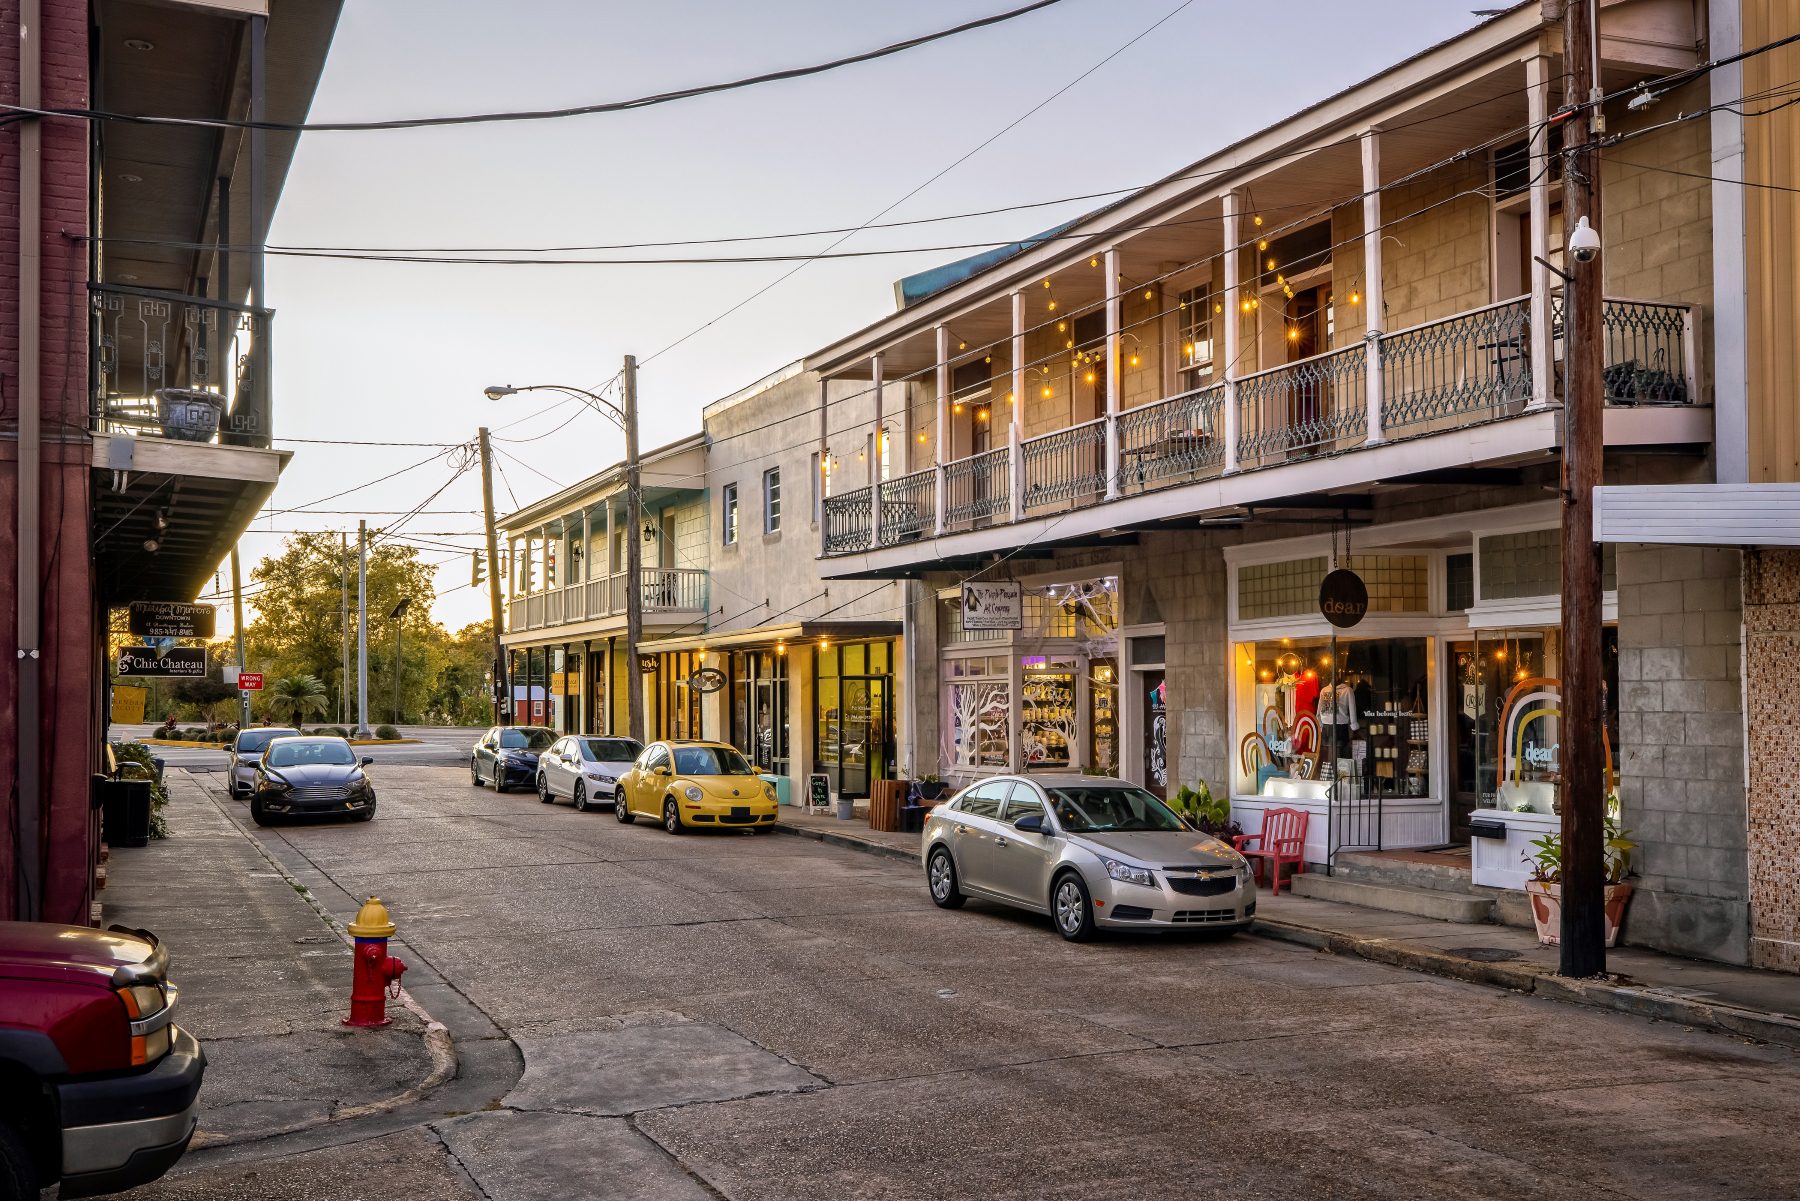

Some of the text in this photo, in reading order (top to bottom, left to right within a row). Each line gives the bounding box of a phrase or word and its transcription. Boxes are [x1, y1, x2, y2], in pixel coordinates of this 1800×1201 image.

[1324, 598, 1364, 614] dear
[133, 658, 203, 669] Chic Chateau
[1525, 741, 1560, 764] dear
